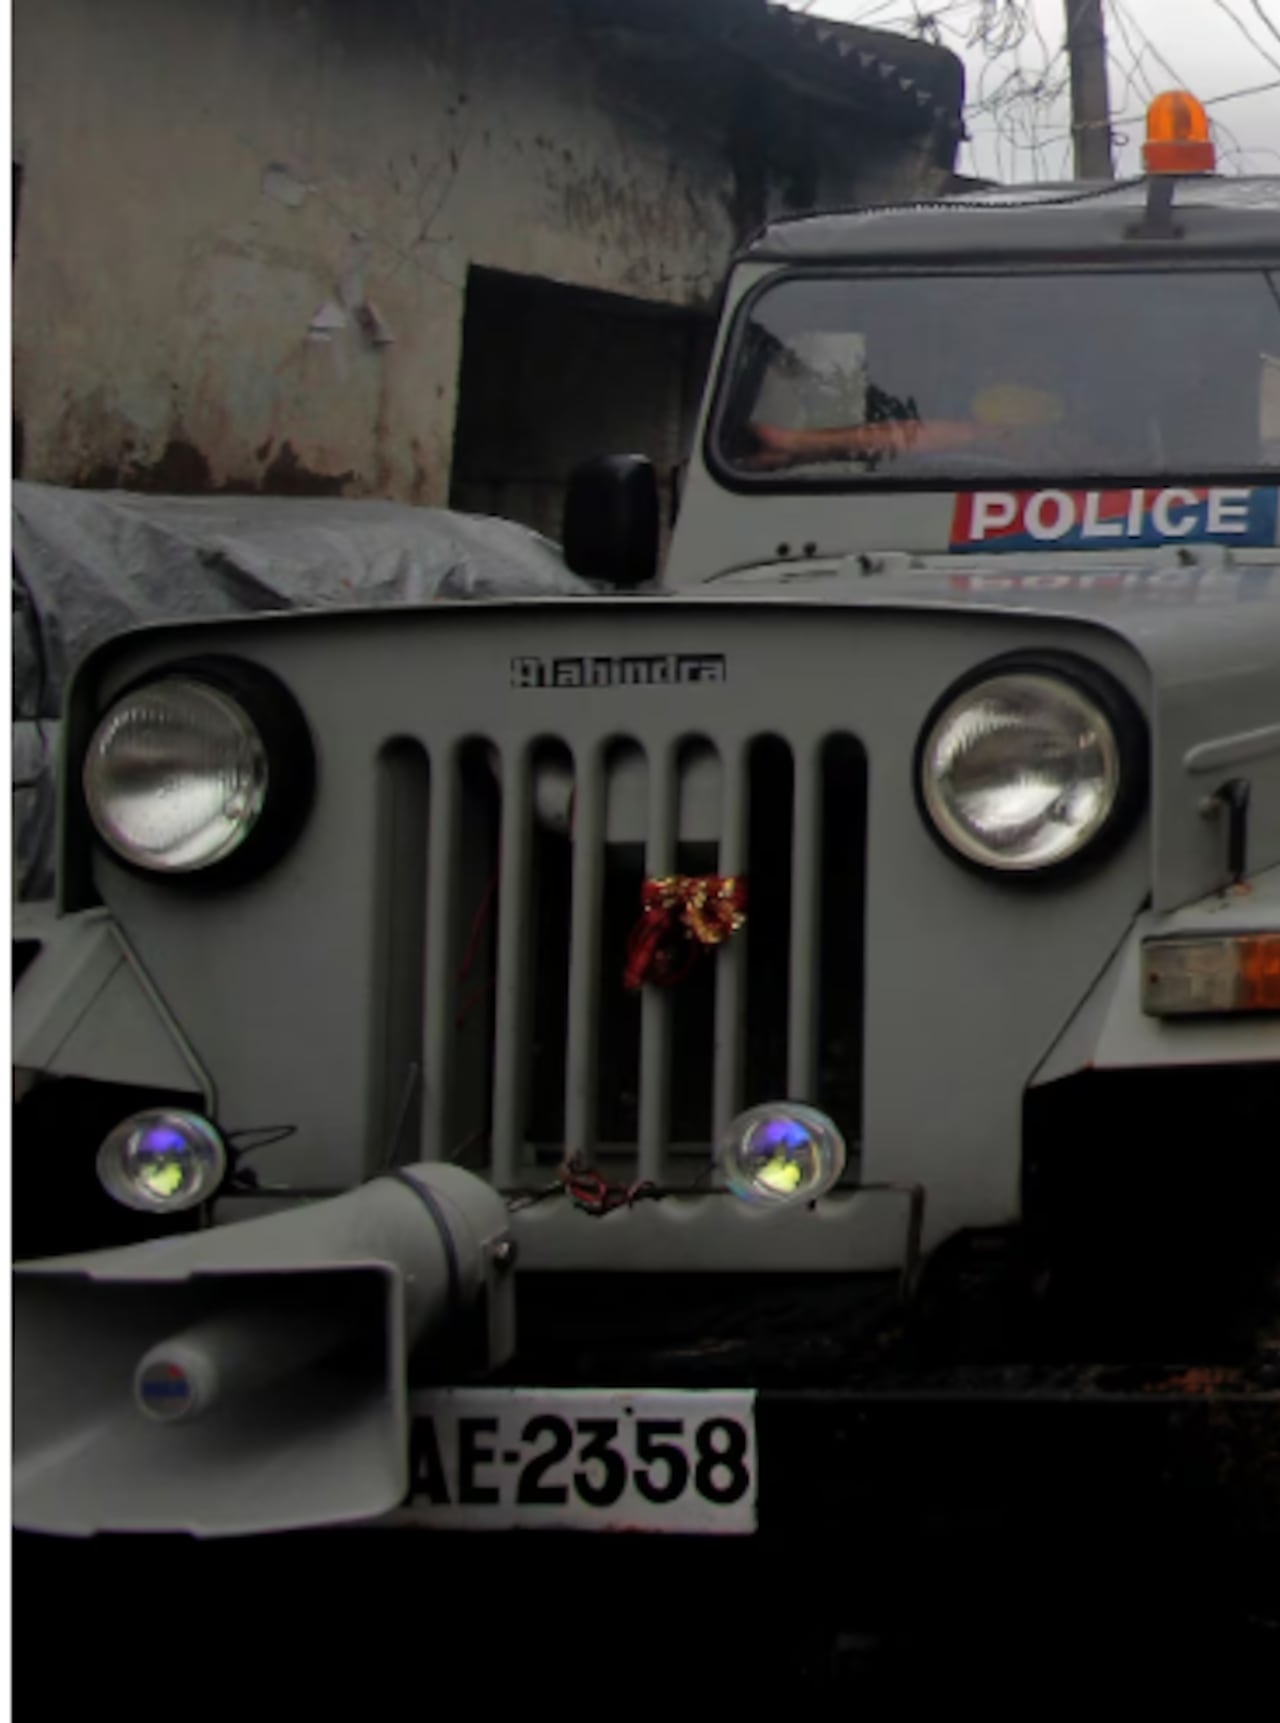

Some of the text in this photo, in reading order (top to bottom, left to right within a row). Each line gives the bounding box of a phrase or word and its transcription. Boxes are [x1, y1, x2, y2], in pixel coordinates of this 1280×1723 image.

[969, 488, 1252, 540] POLICE
[510, 654, 726, 688] Mahindra
[403, 1414, 751, 1507] AE-2358
